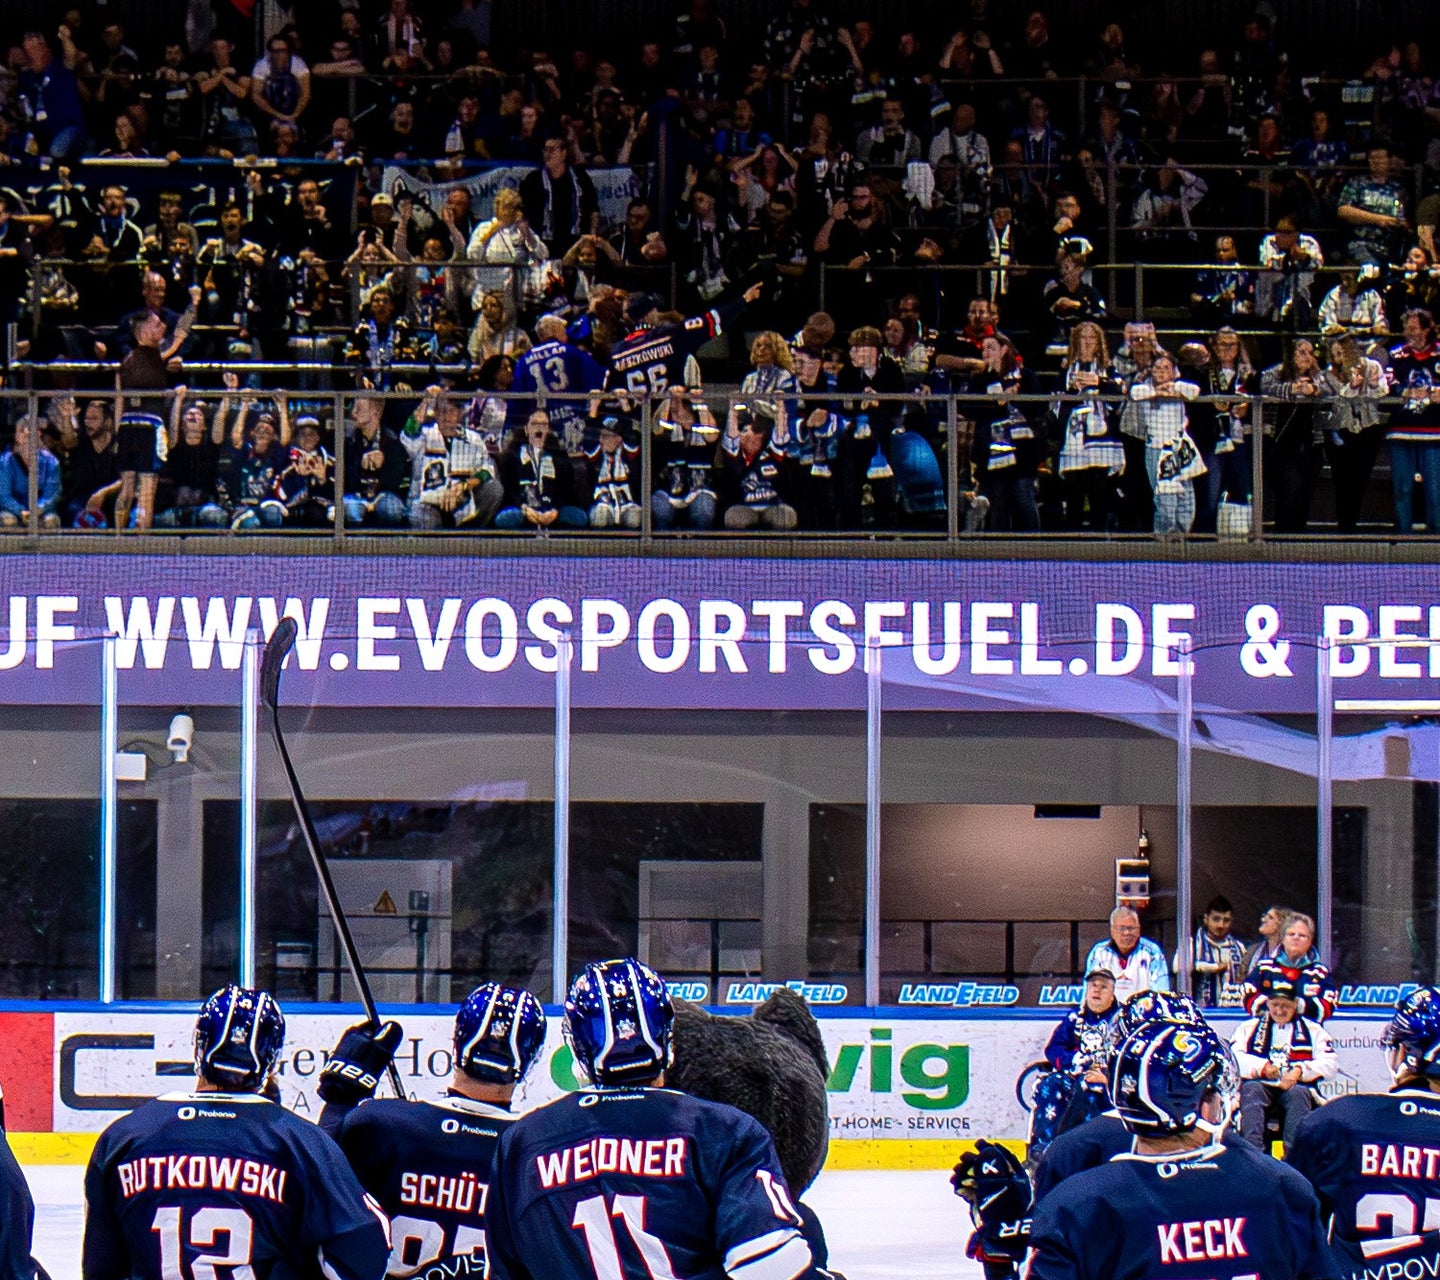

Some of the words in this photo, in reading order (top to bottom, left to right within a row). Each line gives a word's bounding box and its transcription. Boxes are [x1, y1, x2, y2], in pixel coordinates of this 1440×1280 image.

[528, 356, 569, 391] 13
[103, 595, 1196, 676] WWW.EVOSPORTSFUEL.DE
[1239, 603, 1295, 678] &
[898, 981, 1021, 1008] LANDEFELD
[1339, 984, 1420, 1005] LANDE
[907, 1116, 972, 1132] SERVICE
[116, 1153, 289, 1206] RUTKOWSKI
[536, 1135, 688, 1191] WEIDNER
[400, 1170, 490, 1216] SCHÜT
[1156, 1217, 1249, 1265] KECK
